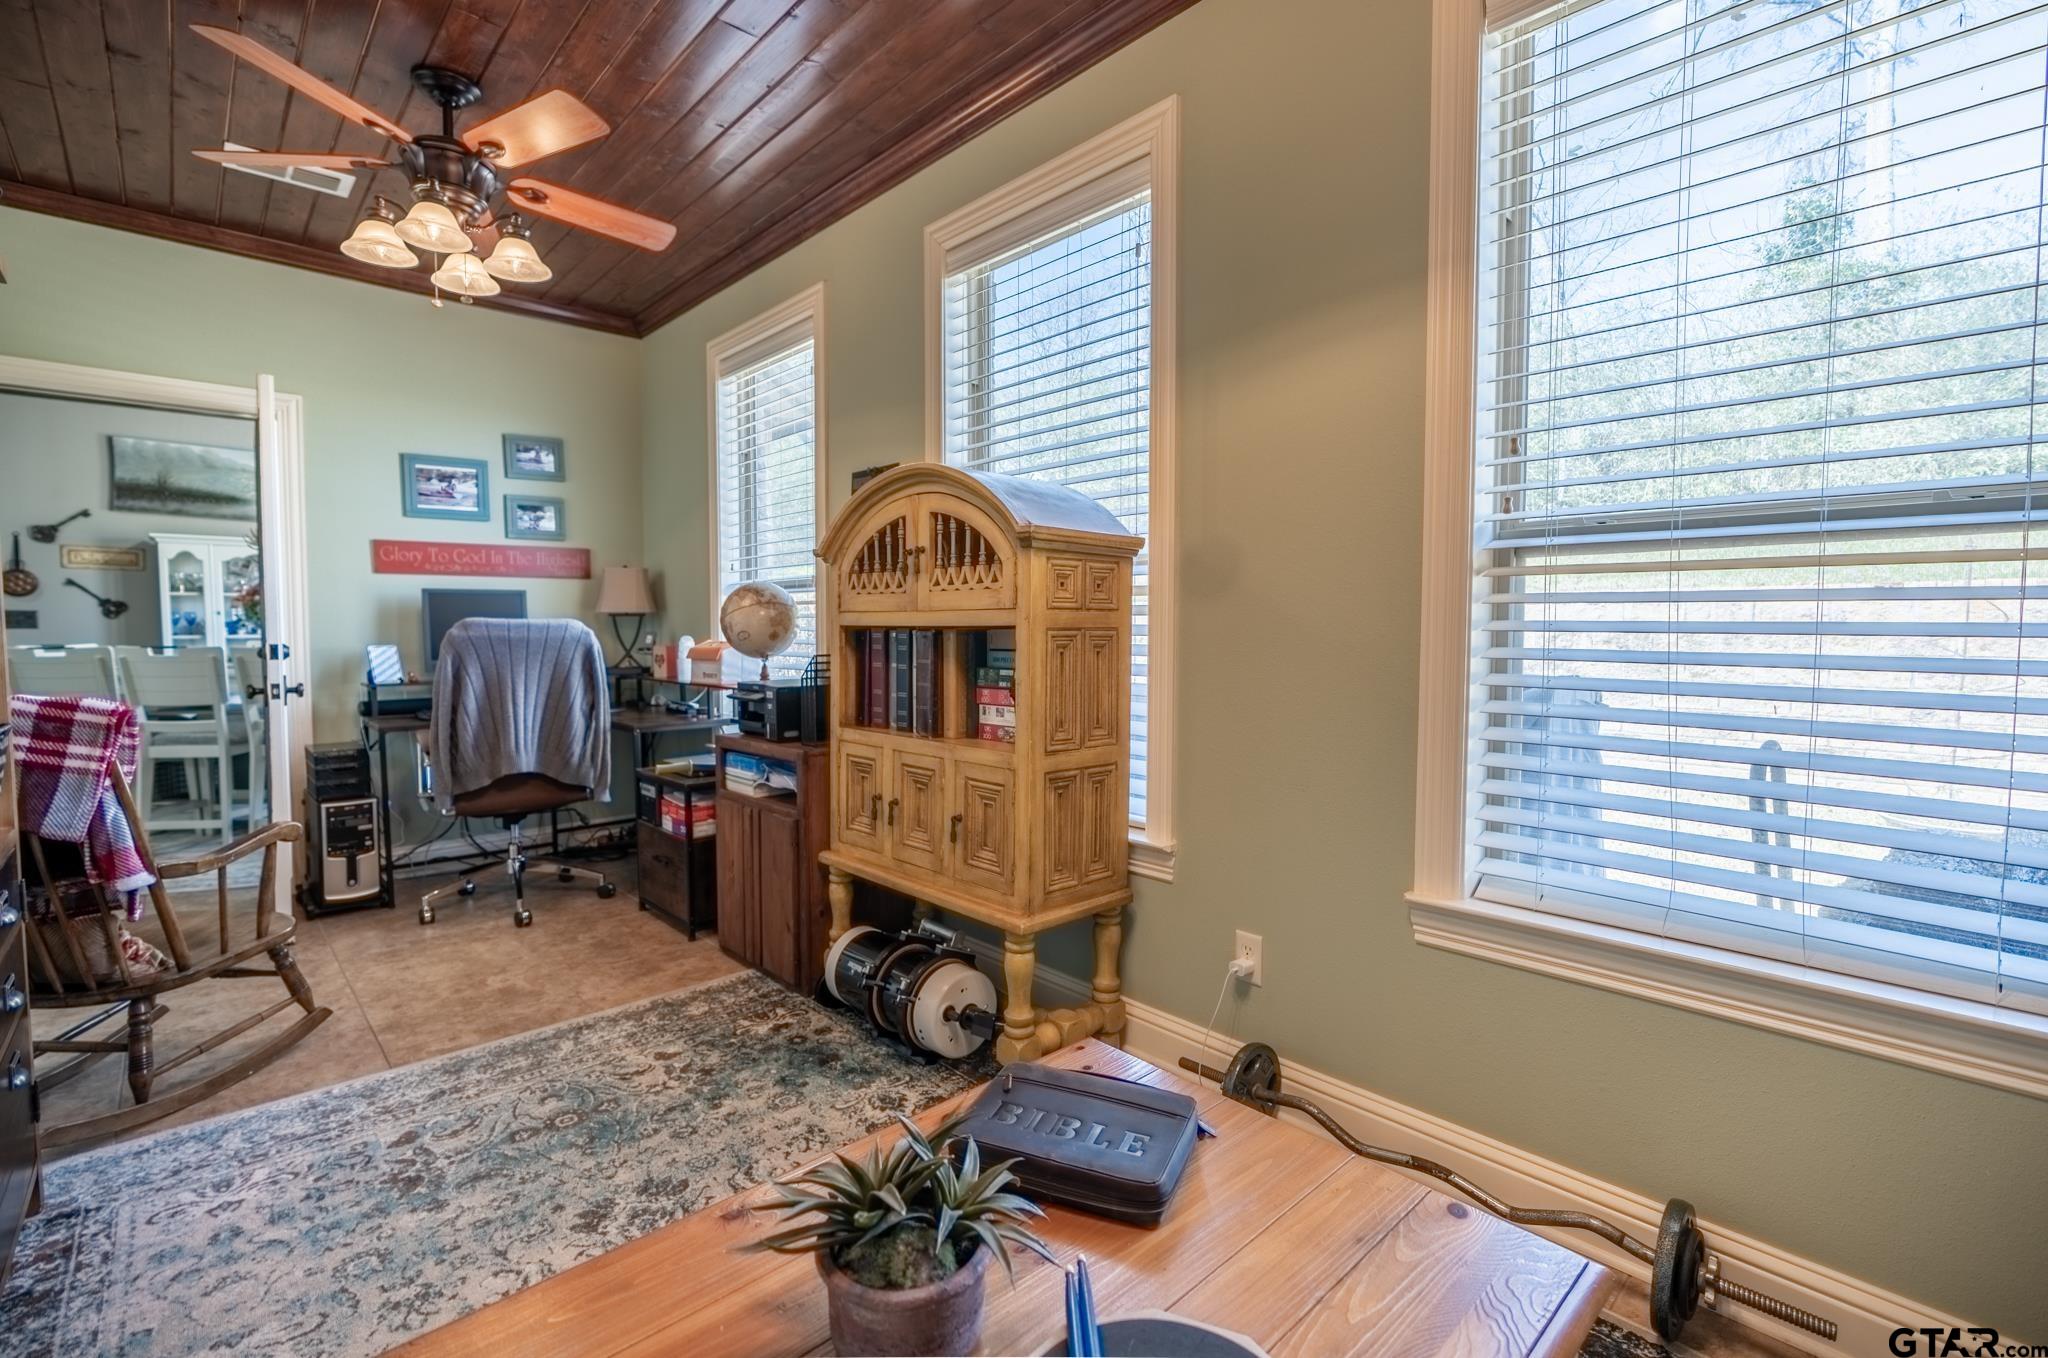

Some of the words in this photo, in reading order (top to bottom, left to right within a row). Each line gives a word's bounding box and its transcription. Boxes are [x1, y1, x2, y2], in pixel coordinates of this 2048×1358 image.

[380, 545, 423, 566] Glory
[428, 547, 449, 562] To
[453, 548, 486, 564] God
[490, 550, 503, 564] In
[506, 551, 532, 565] The
[988, 1101, 1151, 1158] BIBLE
